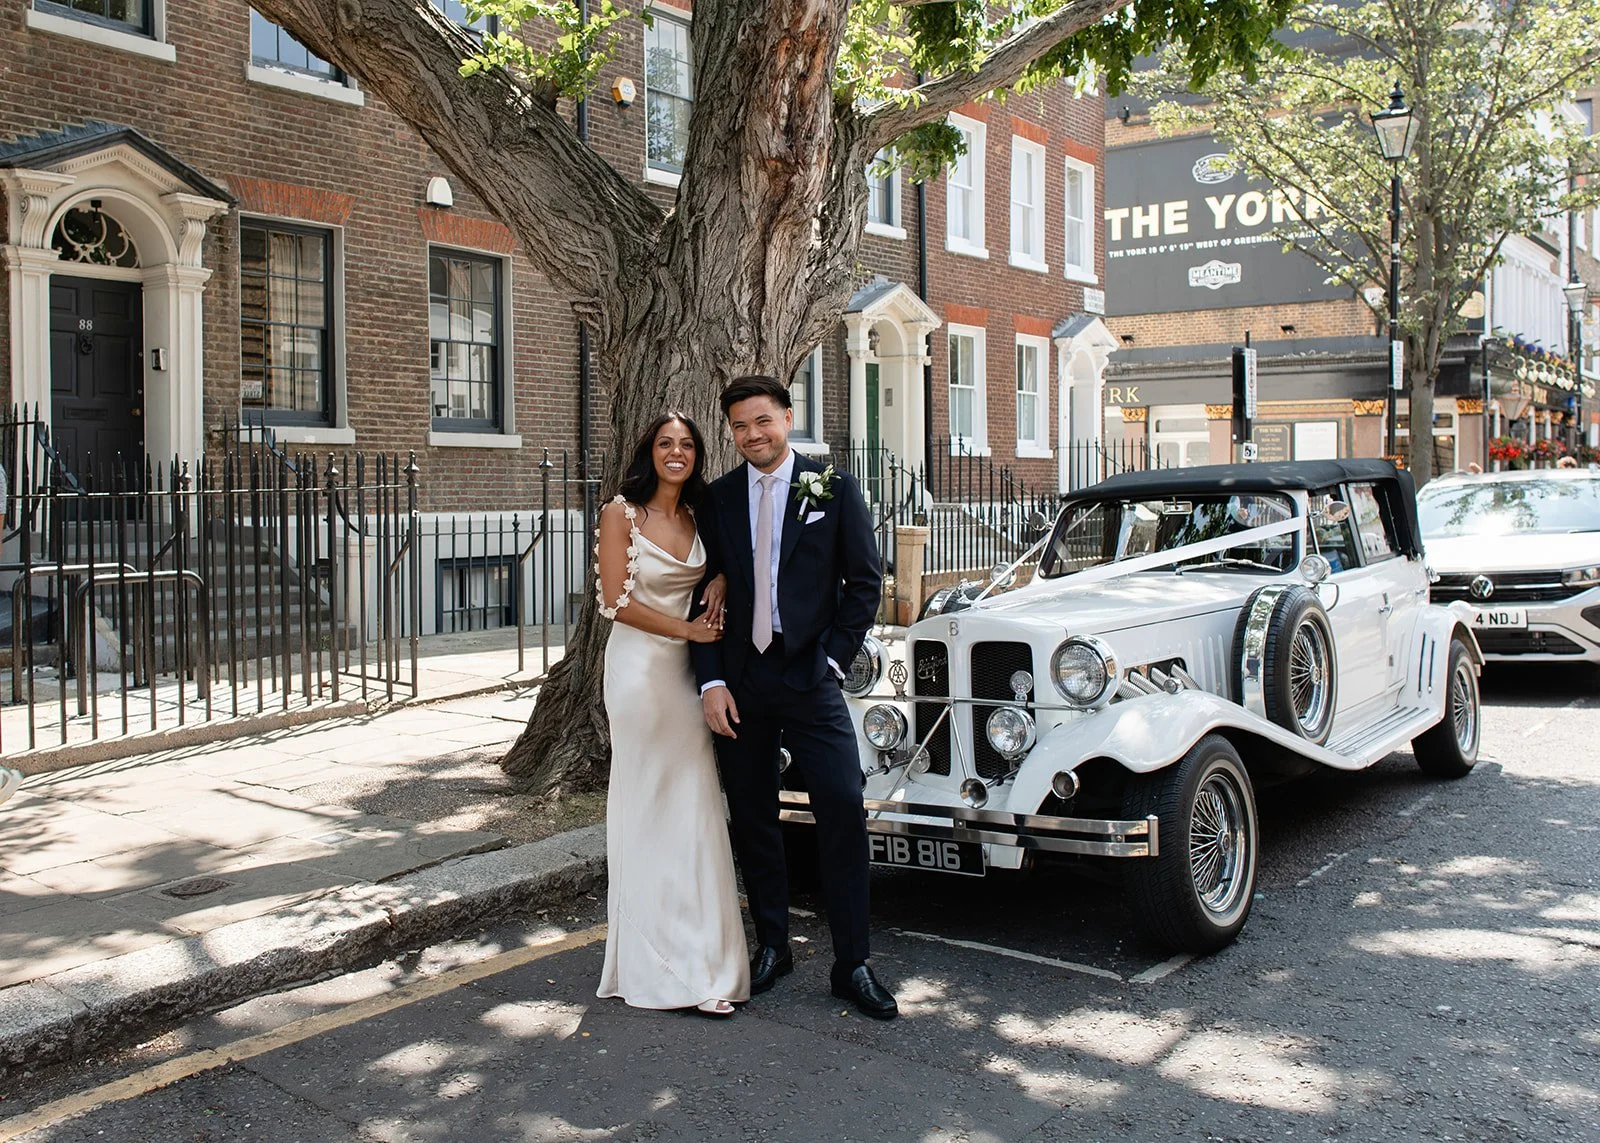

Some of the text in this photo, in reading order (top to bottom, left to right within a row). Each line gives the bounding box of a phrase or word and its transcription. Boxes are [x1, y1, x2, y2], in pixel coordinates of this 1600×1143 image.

[1104, 185, 1336, 241] THE YORK
[1108, 250, 1124, 258] THE
[1126, 247, 1147, 257] YORK
[1196, 240, 1219, 249] WEST
[1221, 238, 1232, 247] OF
[1192, 266, 1239, 279] MEANTIME
[79, 318, 93, 331] 88
[1109, 386, 1140, 404] RK
[1489, 613, 1519, 625] NDJ
[949, 620, 959, 636] B
[868, 835, 961, 870] FIB 816
